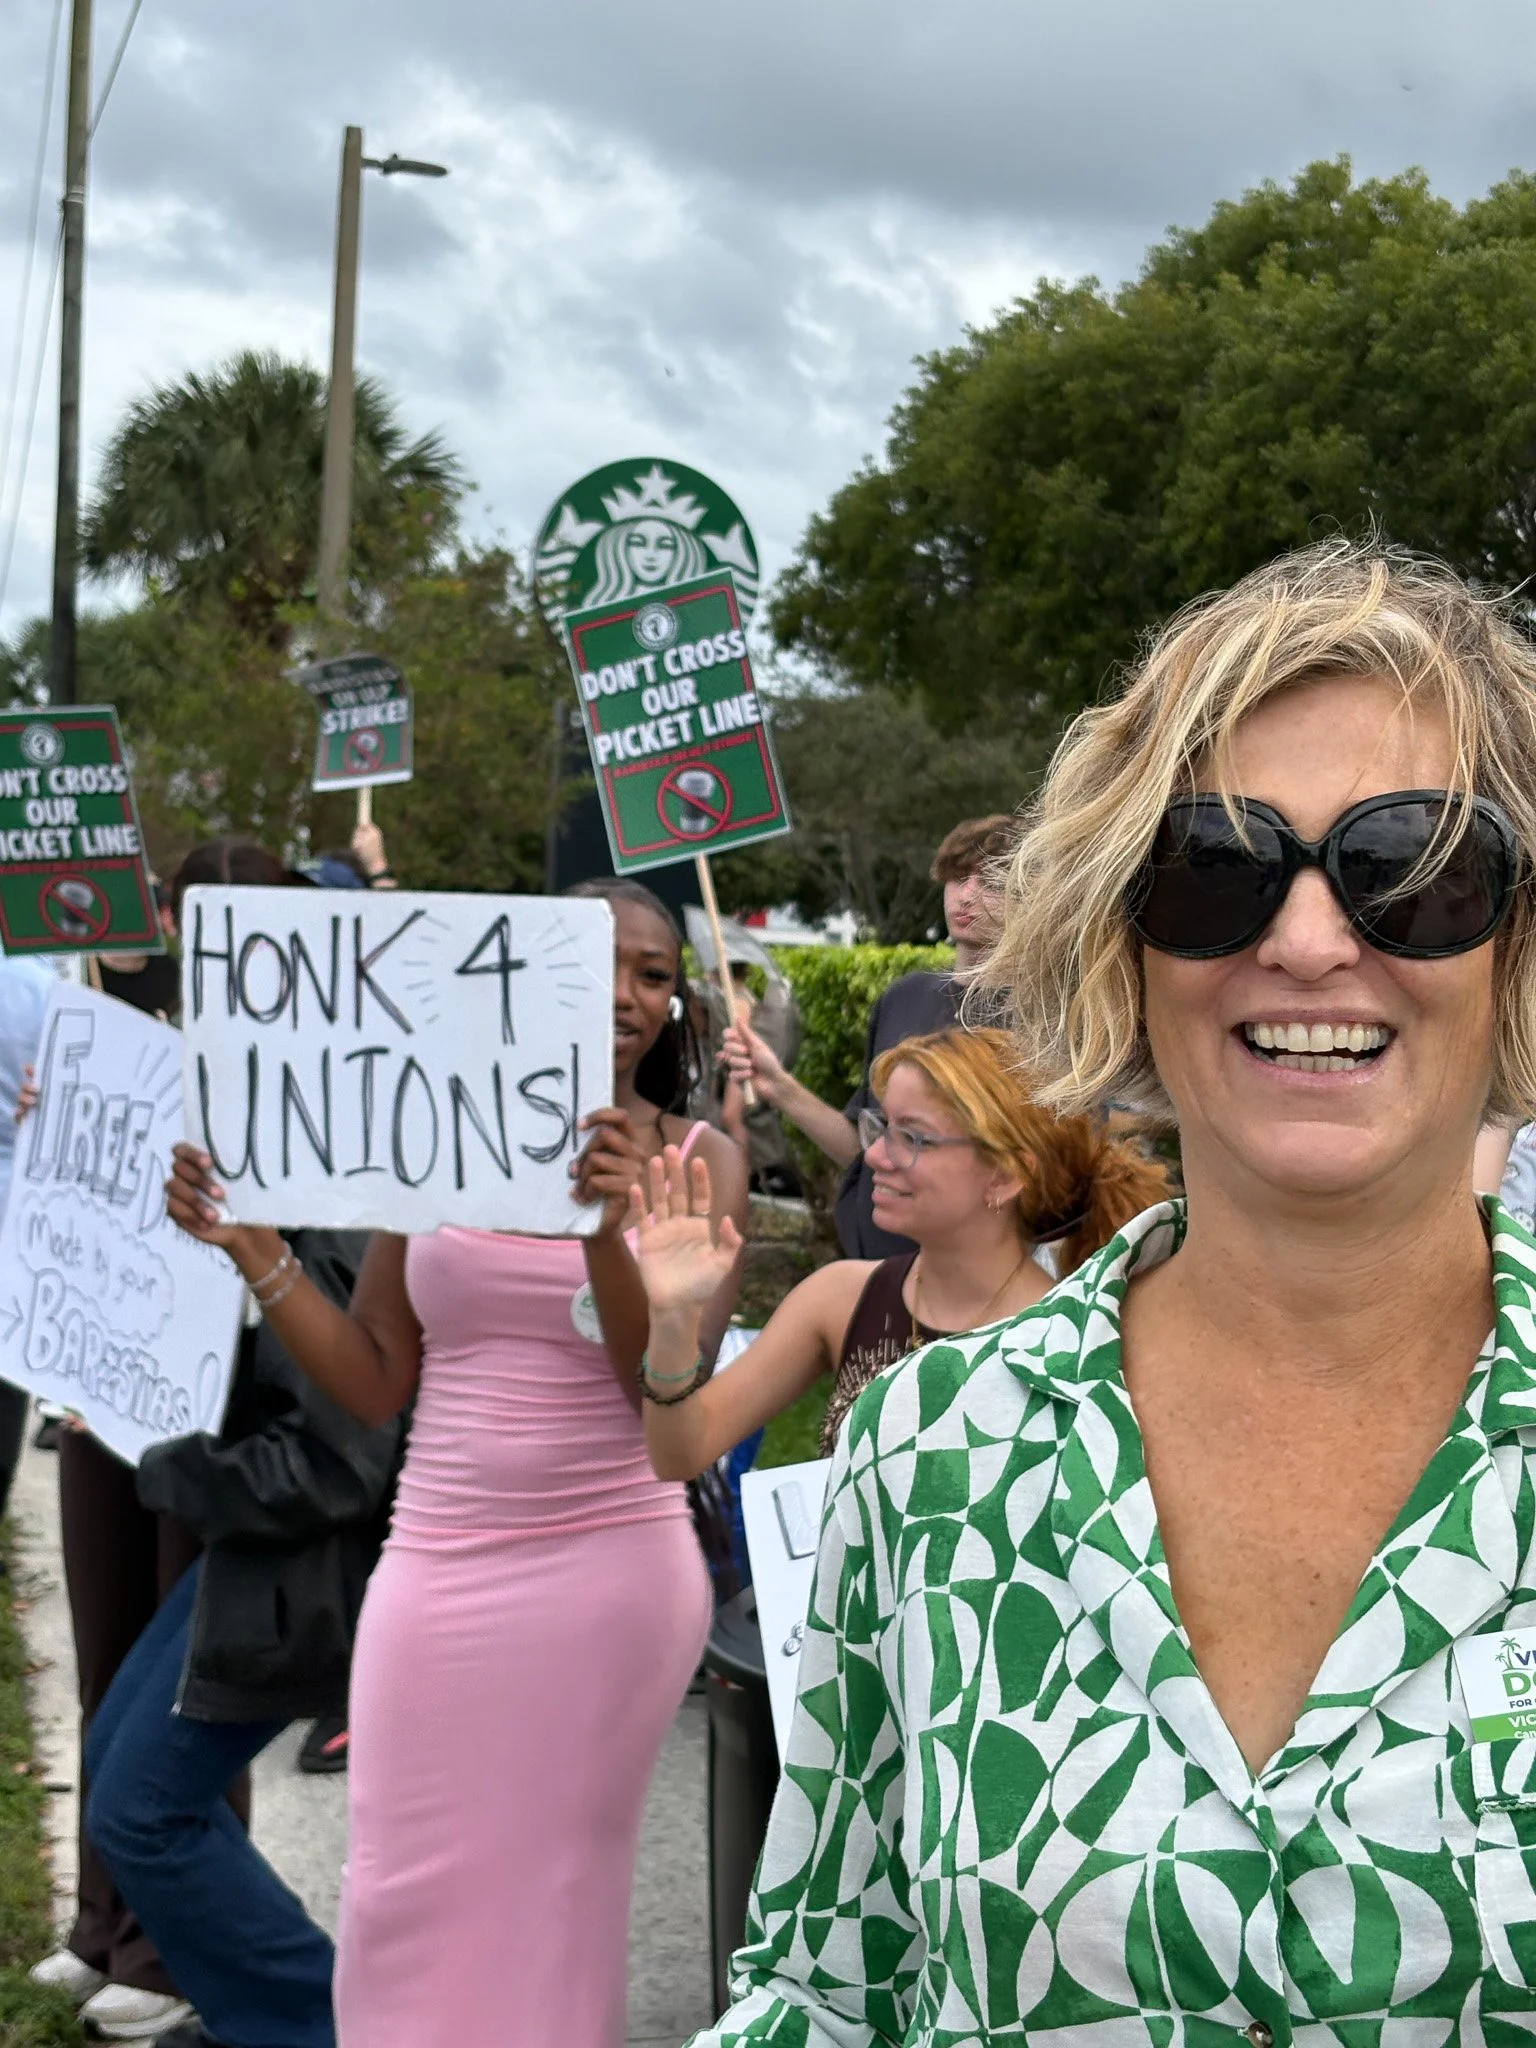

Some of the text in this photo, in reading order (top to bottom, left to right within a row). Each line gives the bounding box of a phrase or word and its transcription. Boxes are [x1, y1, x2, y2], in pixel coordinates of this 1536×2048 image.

[579, 629, 747, 701] DON'T CROSS
[641, 676, 699, 716] OUR
[593, 710, 693, 766] PICKET
[698, 692, 761, 737] LINE
[0, 763, 128, 799] N'T CROSS
[25, 796, 81, 828] OUR
[80, 822, 141, 858] LINE
[193, 902, 527, 1046] HONK 4
[26, 1007, 156, 1208] FREE
[1509, 1698, 1533, 1709] FOR
